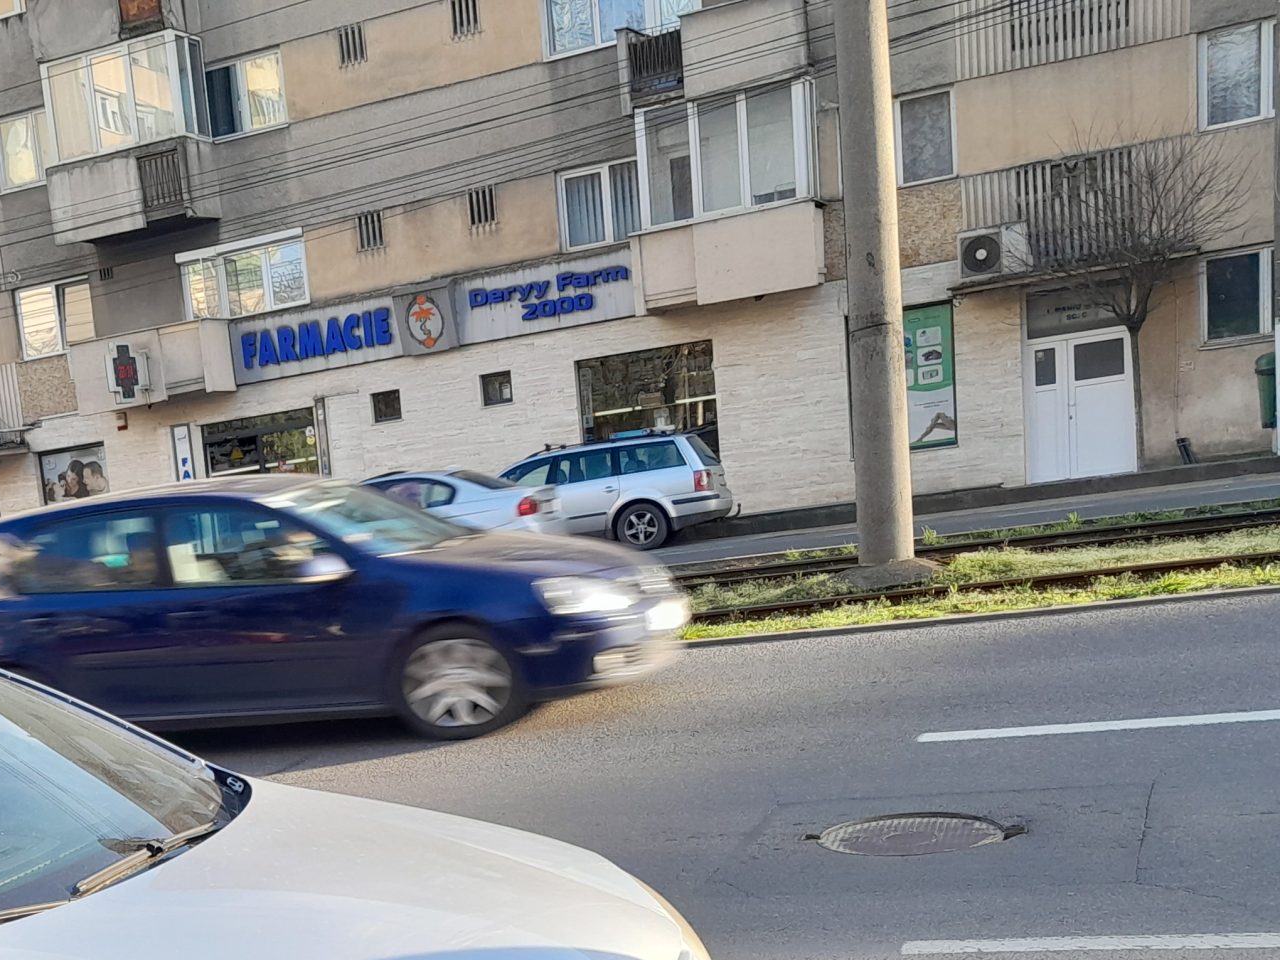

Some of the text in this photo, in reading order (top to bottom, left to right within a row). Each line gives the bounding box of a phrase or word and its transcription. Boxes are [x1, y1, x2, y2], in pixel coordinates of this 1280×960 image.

[469, 265, 629, 308] Deryy Farm
[521, 293, 594, 321] 2000
[241, 307, 392, 369] FARMACIE
